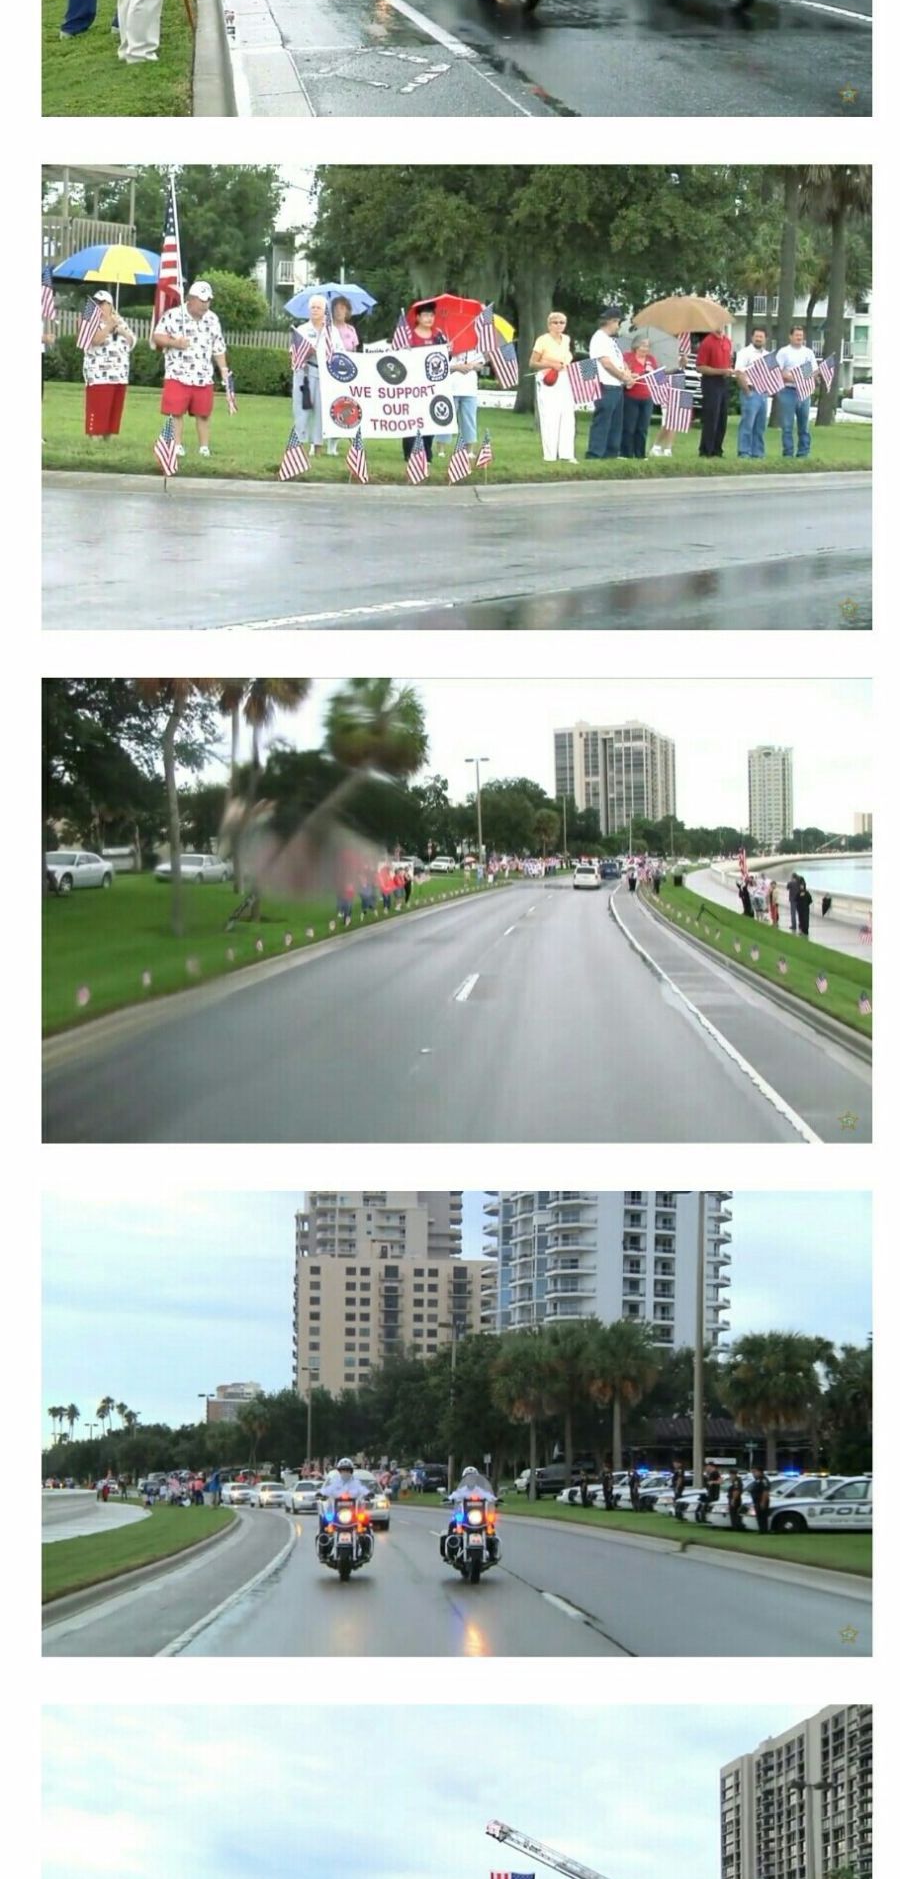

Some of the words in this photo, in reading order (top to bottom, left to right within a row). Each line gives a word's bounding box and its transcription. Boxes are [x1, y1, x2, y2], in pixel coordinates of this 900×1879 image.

[349, 386, 372, 398] WE
[378, 385, 436, 399] SUPPORT
[382, 404, 410, 415] OUR
[370, 417, 424, 431] TROOPS
